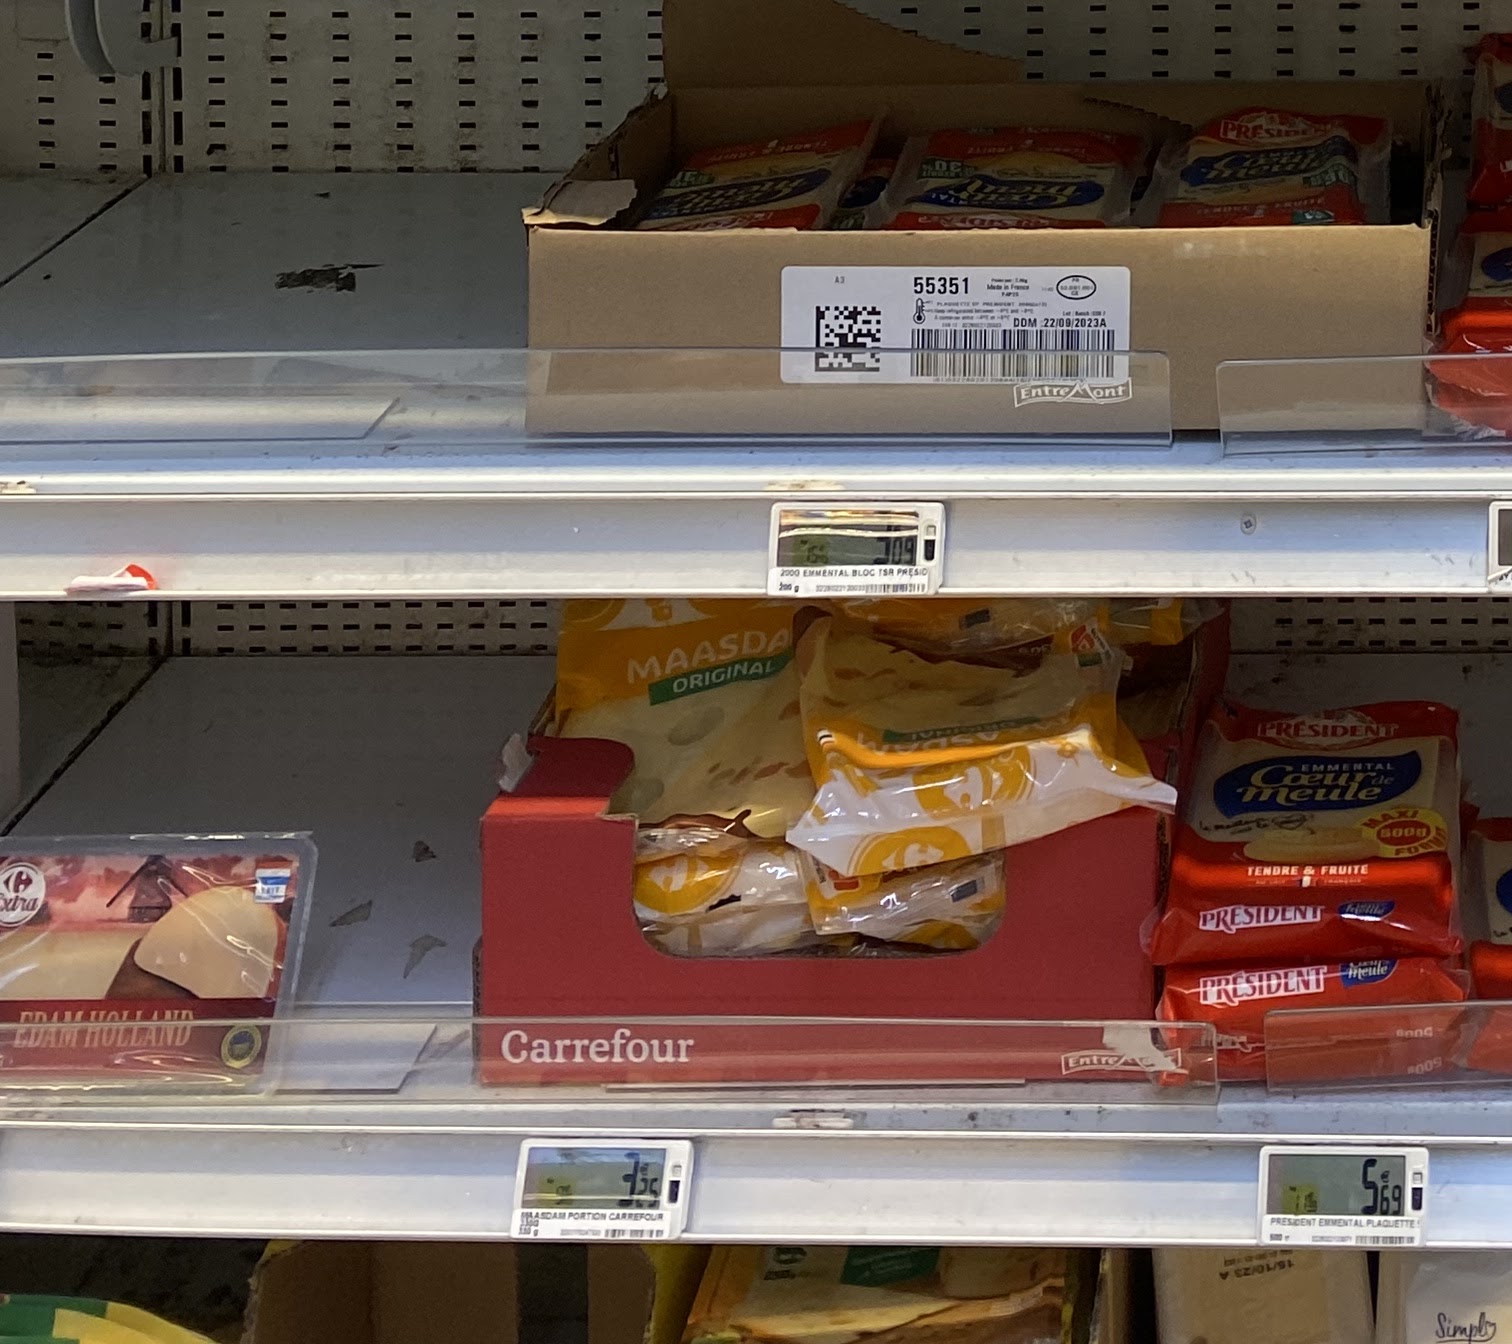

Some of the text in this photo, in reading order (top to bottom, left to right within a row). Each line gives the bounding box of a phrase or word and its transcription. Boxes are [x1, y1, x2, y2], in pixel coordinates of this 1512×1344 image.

[913, 277, 970, 295] 55351
[1013, 318, 1038, 328] DDM
[1021, 379, 1128, 405] EntreMont
[626, 628, 792, 686] MAASDA
[672, 660, 777, 694] ORIGINAL
[1201, 966, 1326, 1004] PRÉSIDENT
[499, 1028, 694, 1064] Carrefour
[609, 1213, 663, 1221] CARREFOUR
[1271, 1218, 1415, 1228] PRESIDENT EMMENTAL PLAQUETTE
